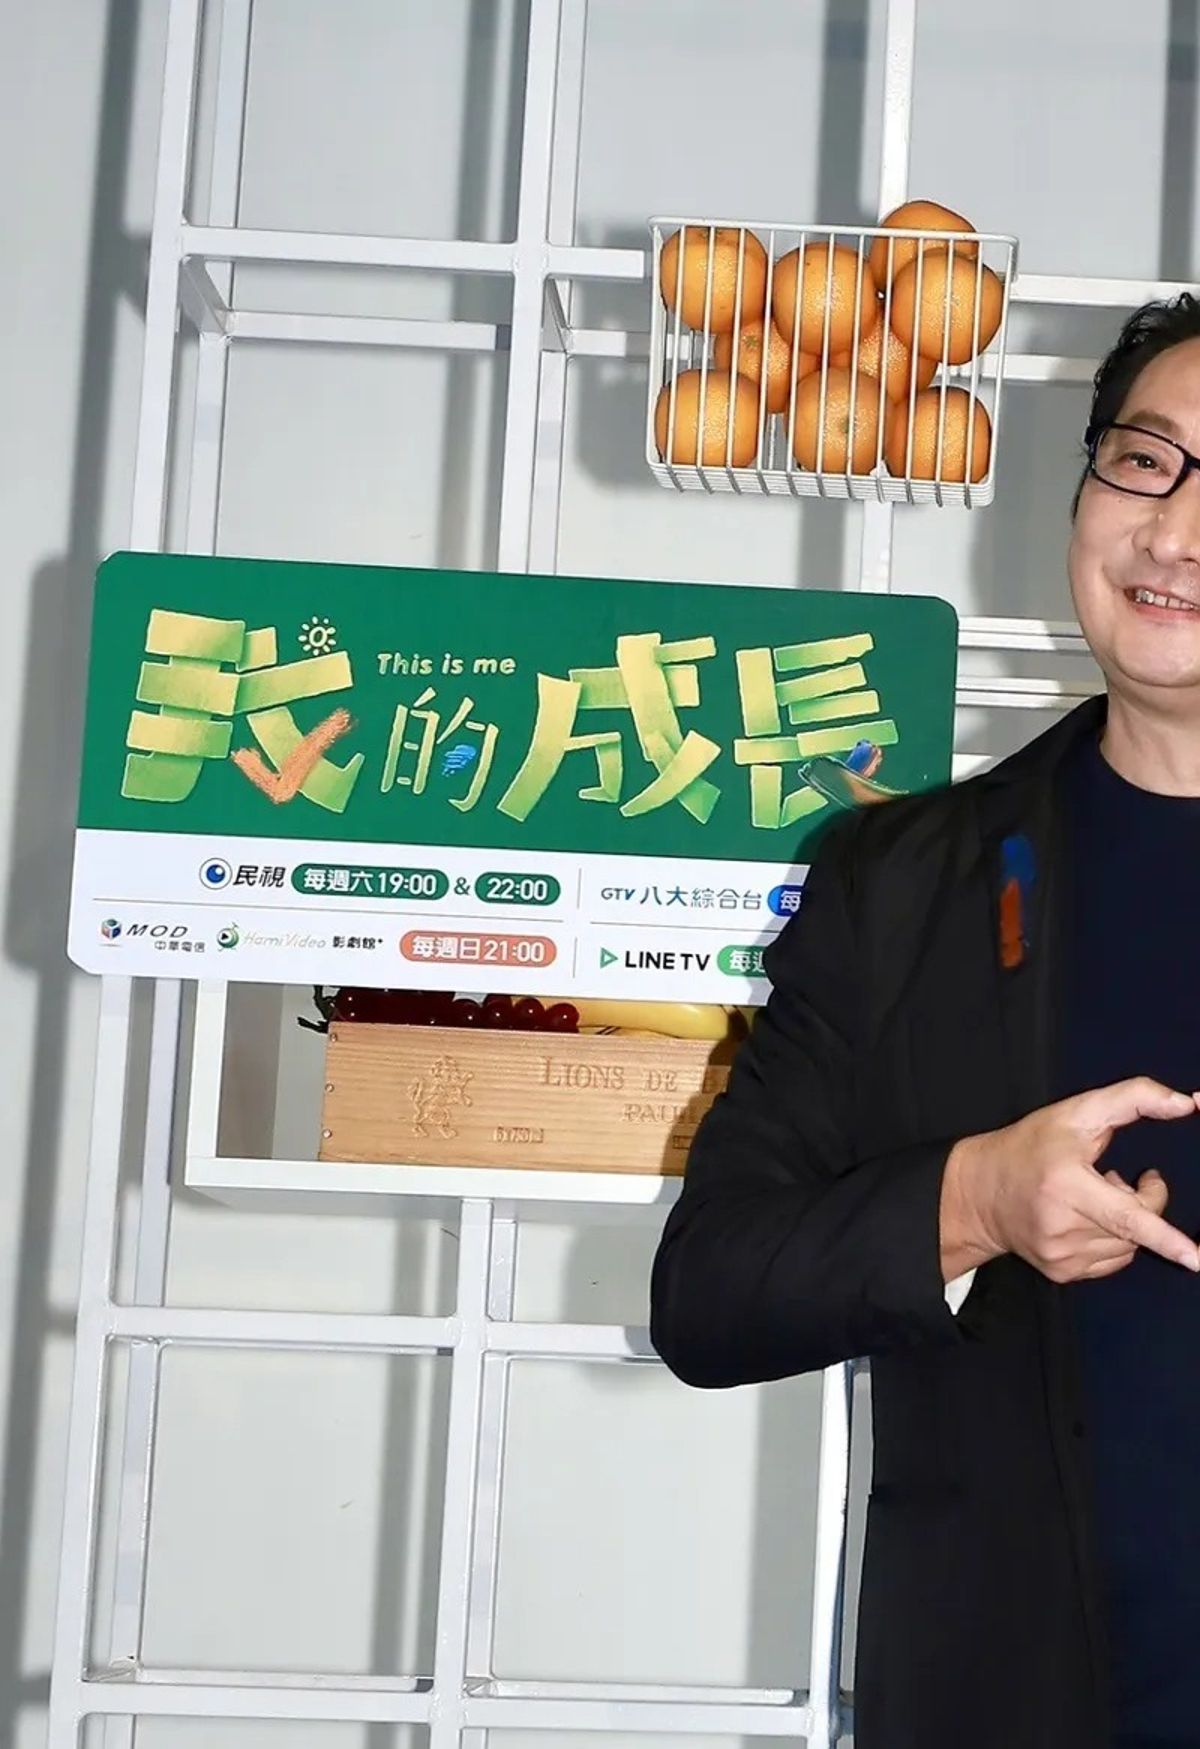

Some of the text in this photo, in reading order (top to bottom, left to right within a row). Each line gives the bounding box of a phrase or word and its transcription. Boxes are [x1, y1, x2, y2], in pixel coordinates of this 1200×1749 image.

[377, 652, 517, 675] This is me
[232, 865, 286, 888] 民視
[453, 877, 470, 895] &
[486, 877, 548, 901] 22:00
[601, 887, 636, 900] GTV
[640, 886, 762, 911] 八大綜合台
[126, 924, 188, 938] MOD
[625, 950, 676, 970] LINE
[680, 953, 711, 972] TV
[543, 1055, 625, 1091] LIONS
